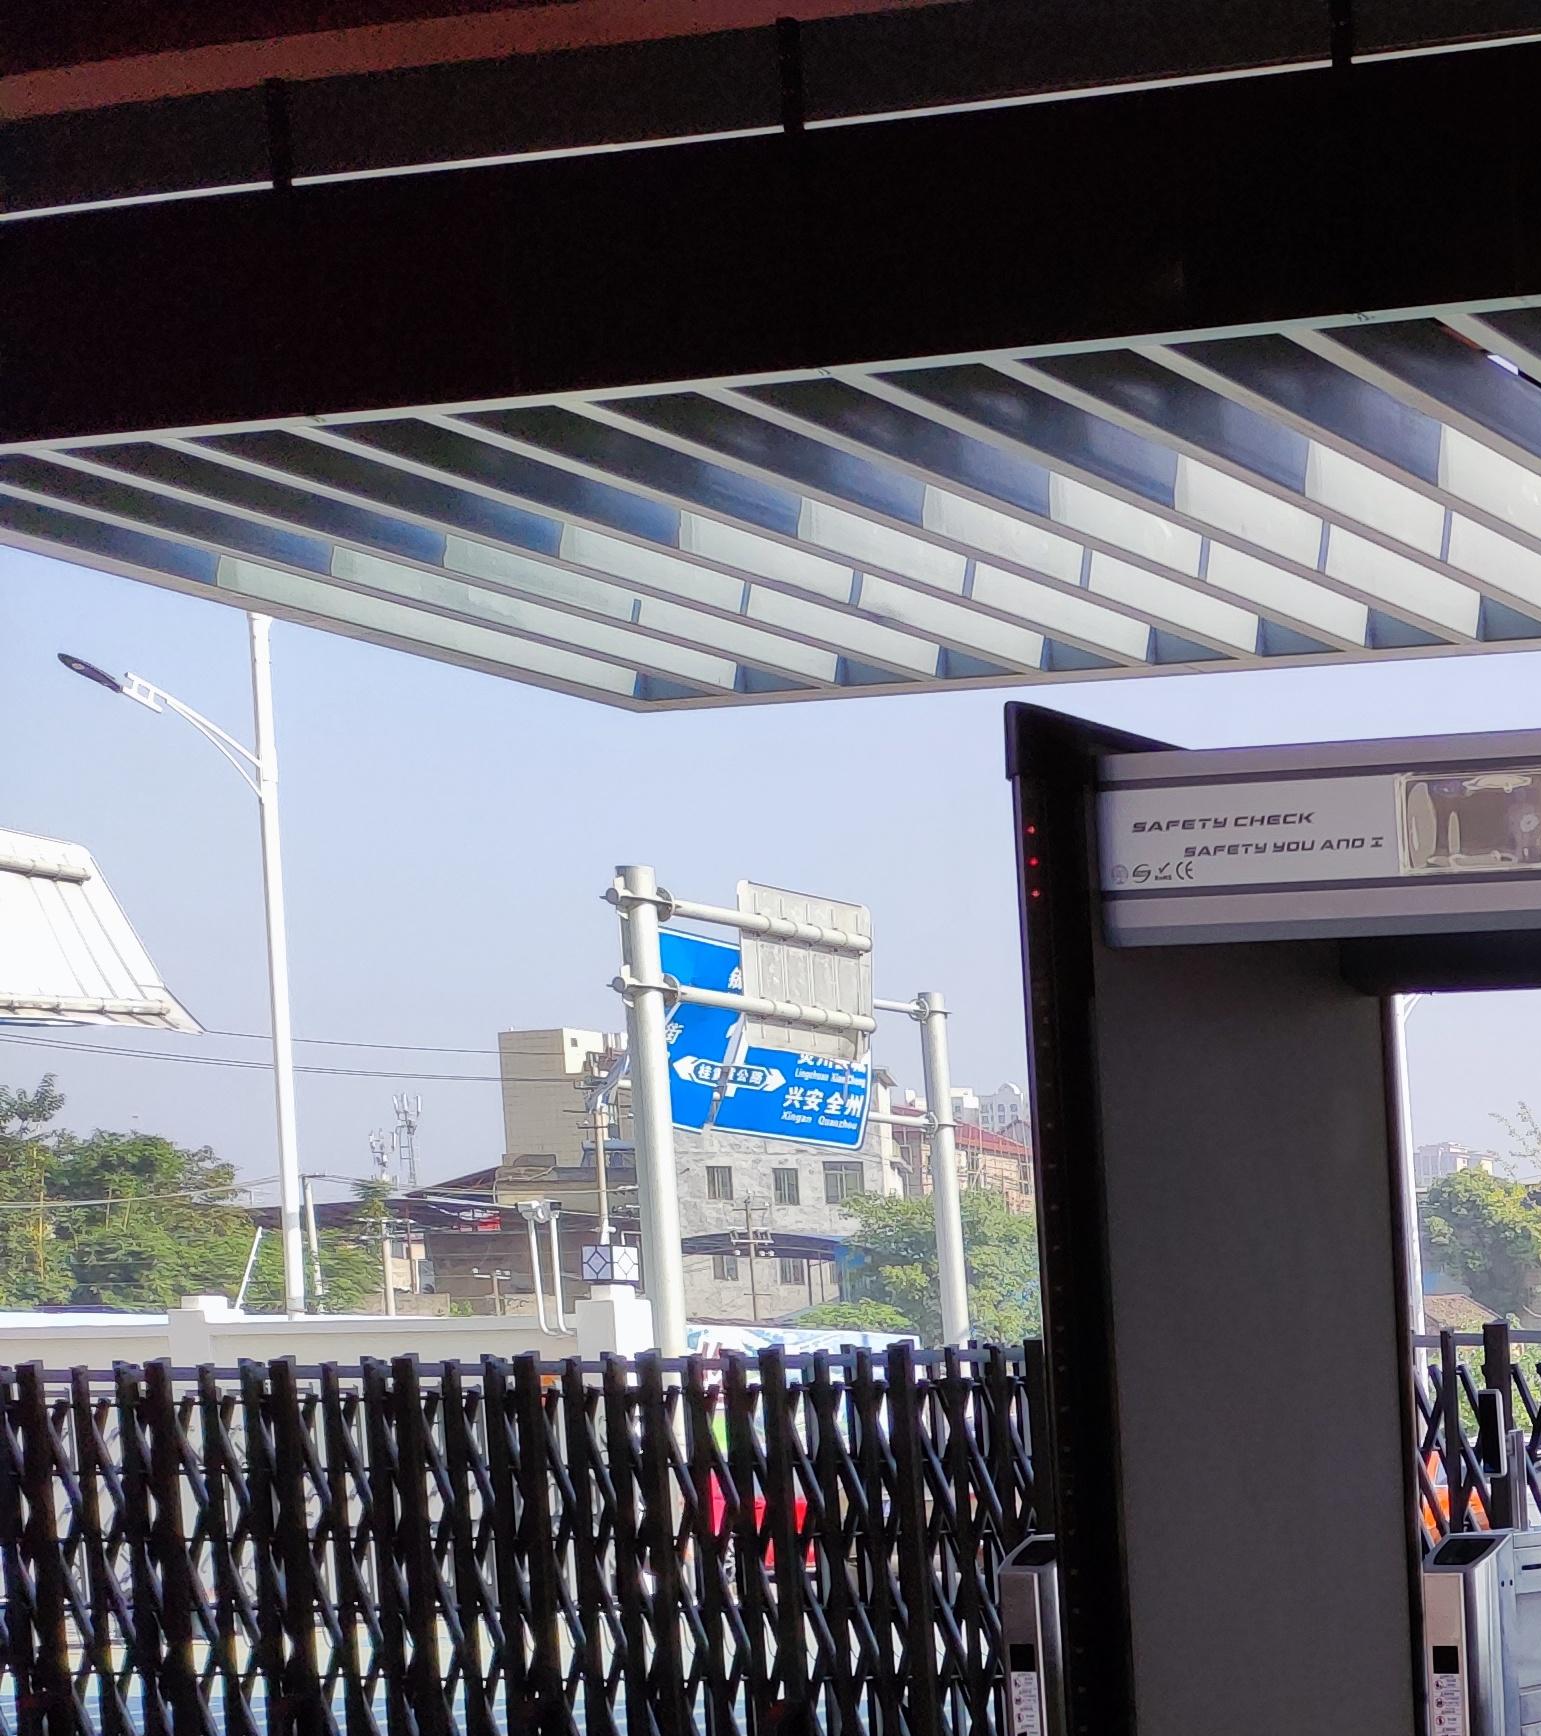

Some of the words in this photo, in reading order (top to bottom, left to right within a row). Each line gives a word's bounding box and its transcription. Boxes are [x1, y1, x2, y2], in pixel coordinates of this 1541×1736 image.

[1132, 817, 1228, 833] SAFETY
[1234, 812, 1315, 828] CHECK
[1184, 842, 1267, 857] SAFETY
[1272, 839, 1315, 854] YOU
